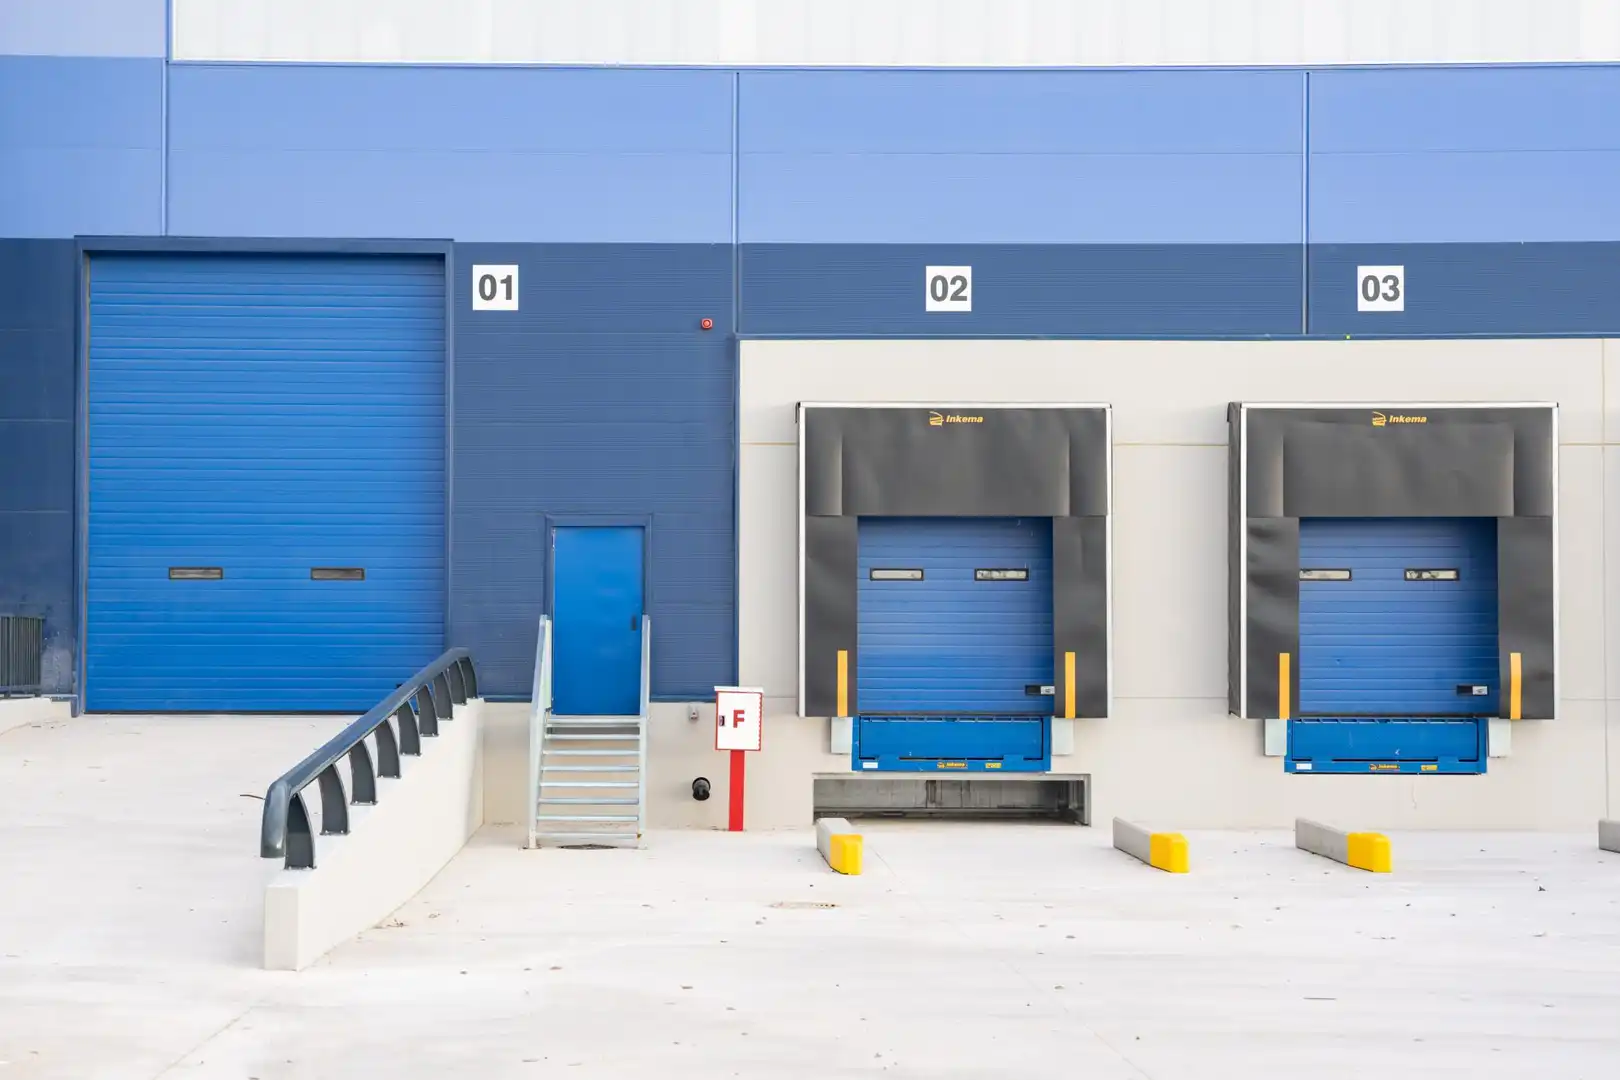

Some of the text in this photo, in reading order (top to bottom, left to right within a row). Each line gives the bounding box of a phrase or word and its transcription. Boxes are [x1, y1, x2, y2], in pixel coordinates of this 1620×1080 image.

[478, 273, 513, 302] 01
[930, 274, 968, 302] 02
[1361, 274, 1400, 302] 03
[946, 415, 984, 423] Inkema
[1389, 415, 1428, 423] Inkema
[733, 709, 745, 728] F
